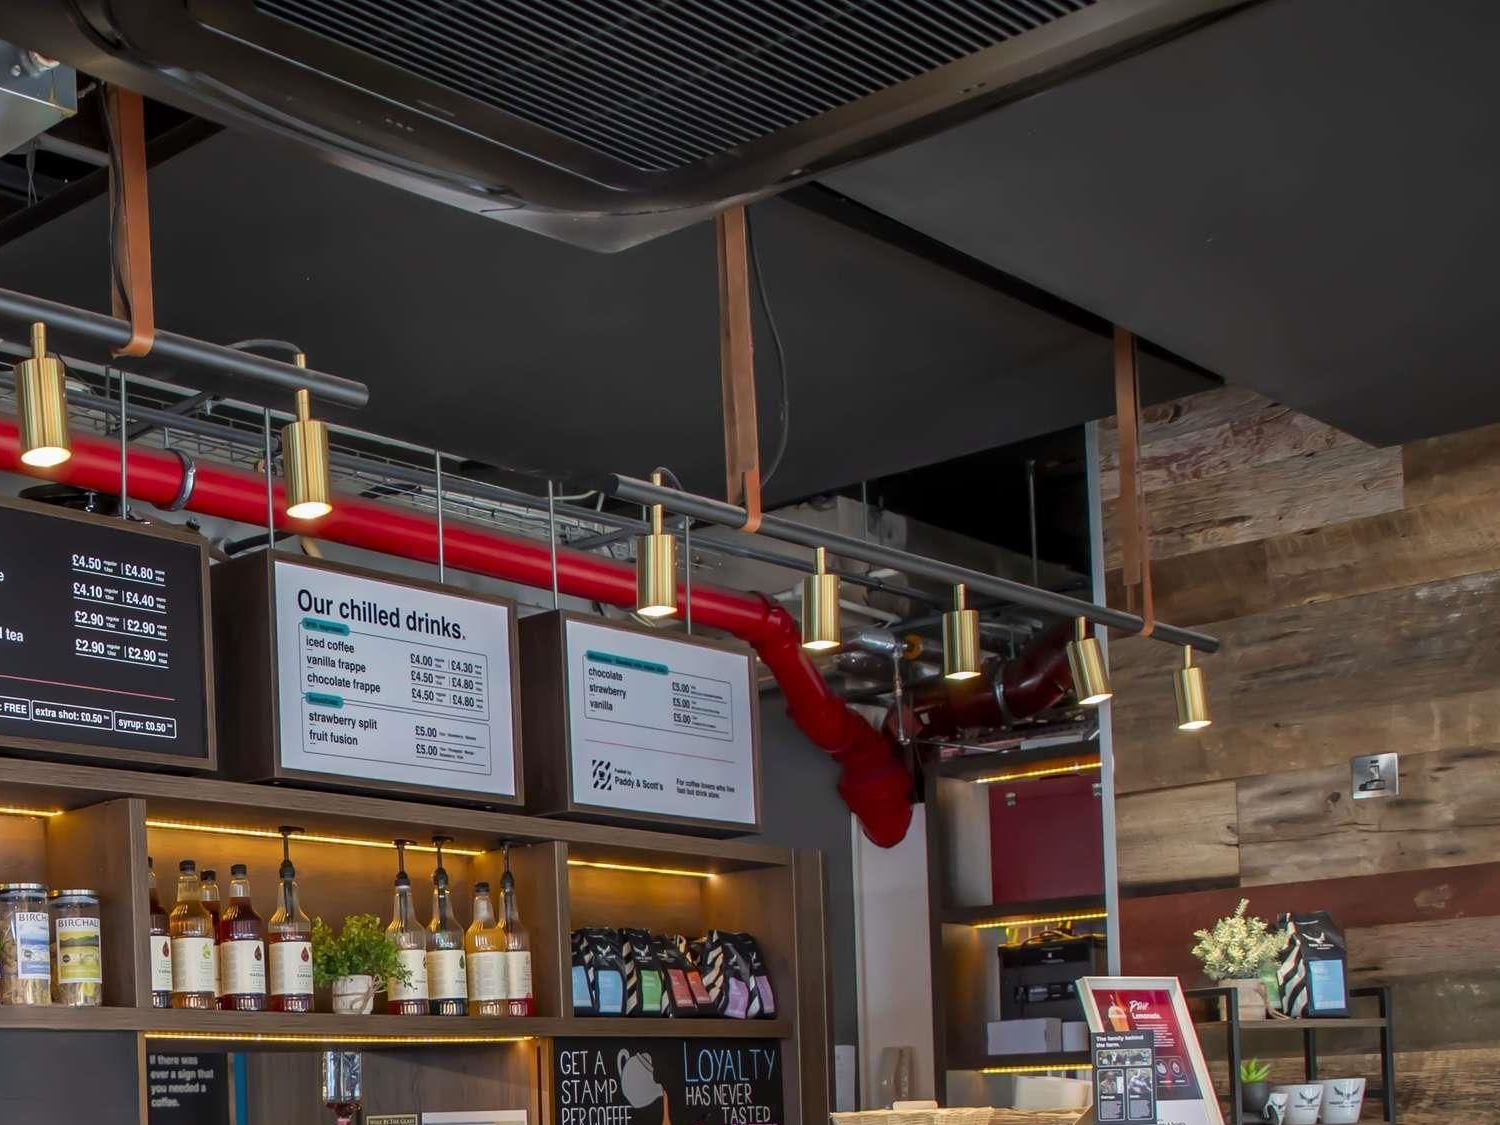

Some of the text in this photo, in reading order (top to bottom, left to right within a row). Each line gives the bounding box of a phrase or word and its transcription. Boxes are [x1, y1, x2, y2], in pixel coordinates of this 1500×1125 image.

[72, 554, 153, 580] £4.50 £4.80
[73, 582, 154, 608] £4.10 £4.40
[75, 611, 155, 635] £2.90 £2.90
[298, 589, 333, 616] Our
[339, 598, 400, 629] chilled
[406, 610, 466, 640] drinks.
[5, 627, 24, 642] tea
[76, 638, 156, 662] £2.90 £2.90
[306, 636, 354, 654] iced coffee
[306, 656, 366, 674] vanilla frappe
[410, 654, 473, 673] £4.00 £4.30
[411, 670, 474, 690] £4.50 £4.80
[588, 666, 623, 681] chocolate
[307, 672, 380, 694] chocolate frappe
[590, 684, 626, 700] strawberry
[412, 688, 474, 707] £4.50 £4.80
[590, 700, 613, 711] vanilla
[4, 702, 27, 714] FREE
[35, 708, 102, 724] extra shot: £0.50
[118, 718, 166, 732] syrup: £0.50
[308, 712, 377, 731] strawberry split
[309, 729, 358, 746] fruit fusion
[416, 726, 437, 738] £5.00
[416, 744, 438, 756] £5.00
[615, 776, 664, 790] Paddy & Scott's
[158, 1054, 180, 1065] there
[560, 1050, 606, 1076] GET A
[684, 1041, 776, 1082] LOYALTY
[178, 1068, 196, 1081] sign
[198, 1069, 214, 1079] that
[151, 1084, 167, 1096] you
[168, 1082, 200, 1092] needed
[562, 1080, 618, 1104] STAMP
[686, 1084, 752, 1106] HAS NEVER
[721, 1106, 770, 1124] TASTED
